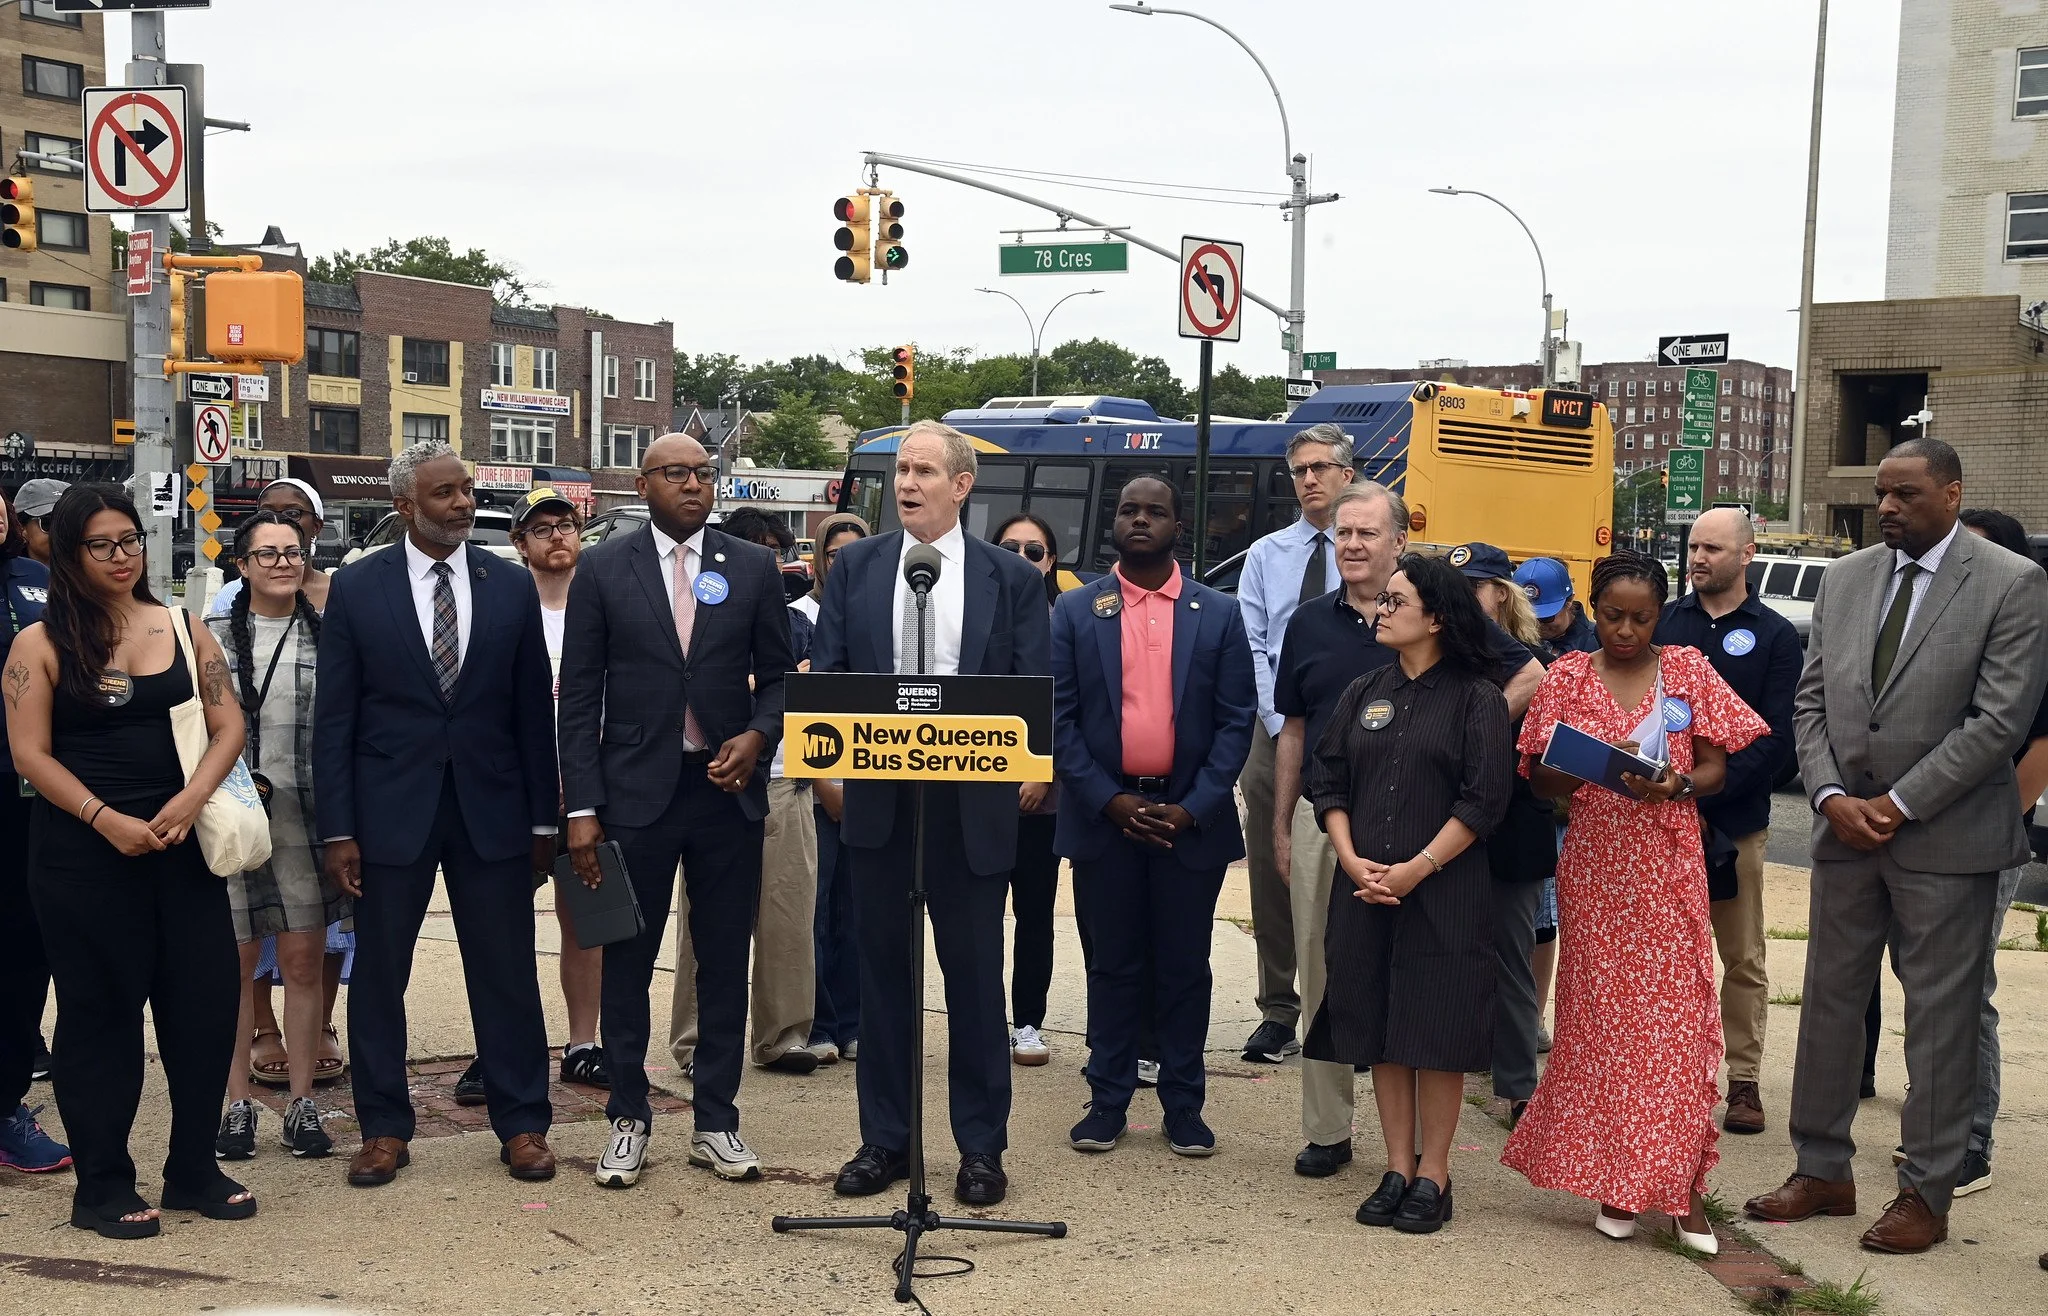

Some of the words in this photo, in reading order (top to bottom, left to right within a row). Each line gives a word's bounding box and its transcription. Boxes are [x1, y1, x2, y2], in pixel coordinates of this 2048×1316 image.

[1034, 249, 1053, 269] 78
[1059, 249, 1093, 269] Cres
[1671, 345, 1691, 357] ONE
[1700, 343, 1721, 356] WAY
[1308, 355, 1317, 368] 78
[1320, 354, 1331, 363] Cres
[195, 381, 209, 392] ONE
[214, 383, 227, 394] WAY
[1289, 385, 1300, 395] ONE
[1300, 386, 1311, 396] WAY
[496, 393, 509, 402] NEW
[510, 393, 538, 405] MILLENIUM
[539, 396, 553, 406] HOME
[554, 398, 567, 407] CARE
[1439, 396, 1465, 409] 8803
[1552, 399, 1584, 416] NYCT
[1140, 432, 1162, 450] NY
[331, 475, 378, 485] REDWOOD
[475, 467, 498, 481] STORE
[500, 468, 512, 482] FOR
[514, 469, 532, 483] RENT
[482, 481, 494, 489] CALL
[568, 485, 578, 498] FOR
[750, 480, 781, 499] Office
[898, 687, 938, 696] QUEENS
[853, 723, 911, 745] New
[916, 724, 1018, 747] Queens
[801, 732, 836, 759] MTA
[853, 748, 902, 771] Bus
[907, 749, 1008, 772] Service
